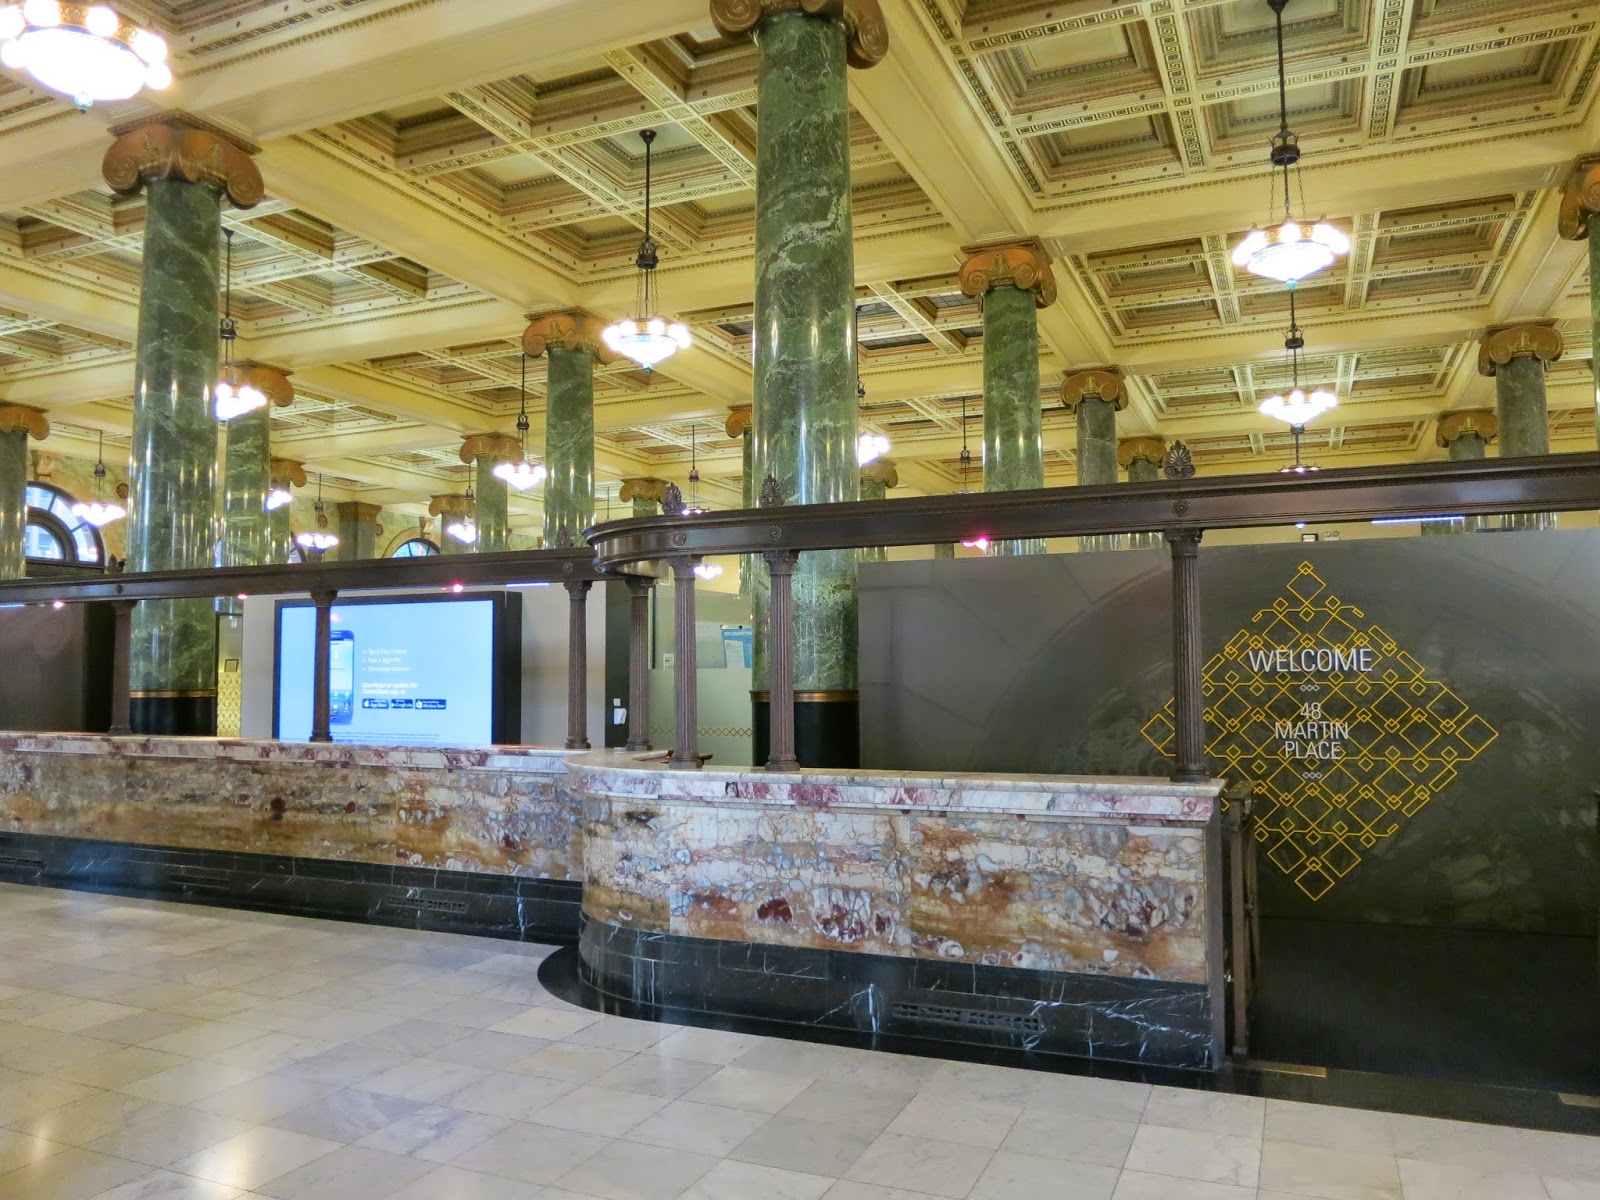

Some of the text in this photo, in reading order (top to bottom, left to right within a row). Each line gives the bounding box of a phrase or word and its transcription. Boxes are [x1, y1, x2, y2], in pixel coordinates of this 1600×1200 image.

[1249, 648, 1373, 672] WELCOME
[1300, 702, 1321, 720] 48
[1275, 721, 1349, 740] MARTIN
[1285, 741, 1341, 759] PLACE
